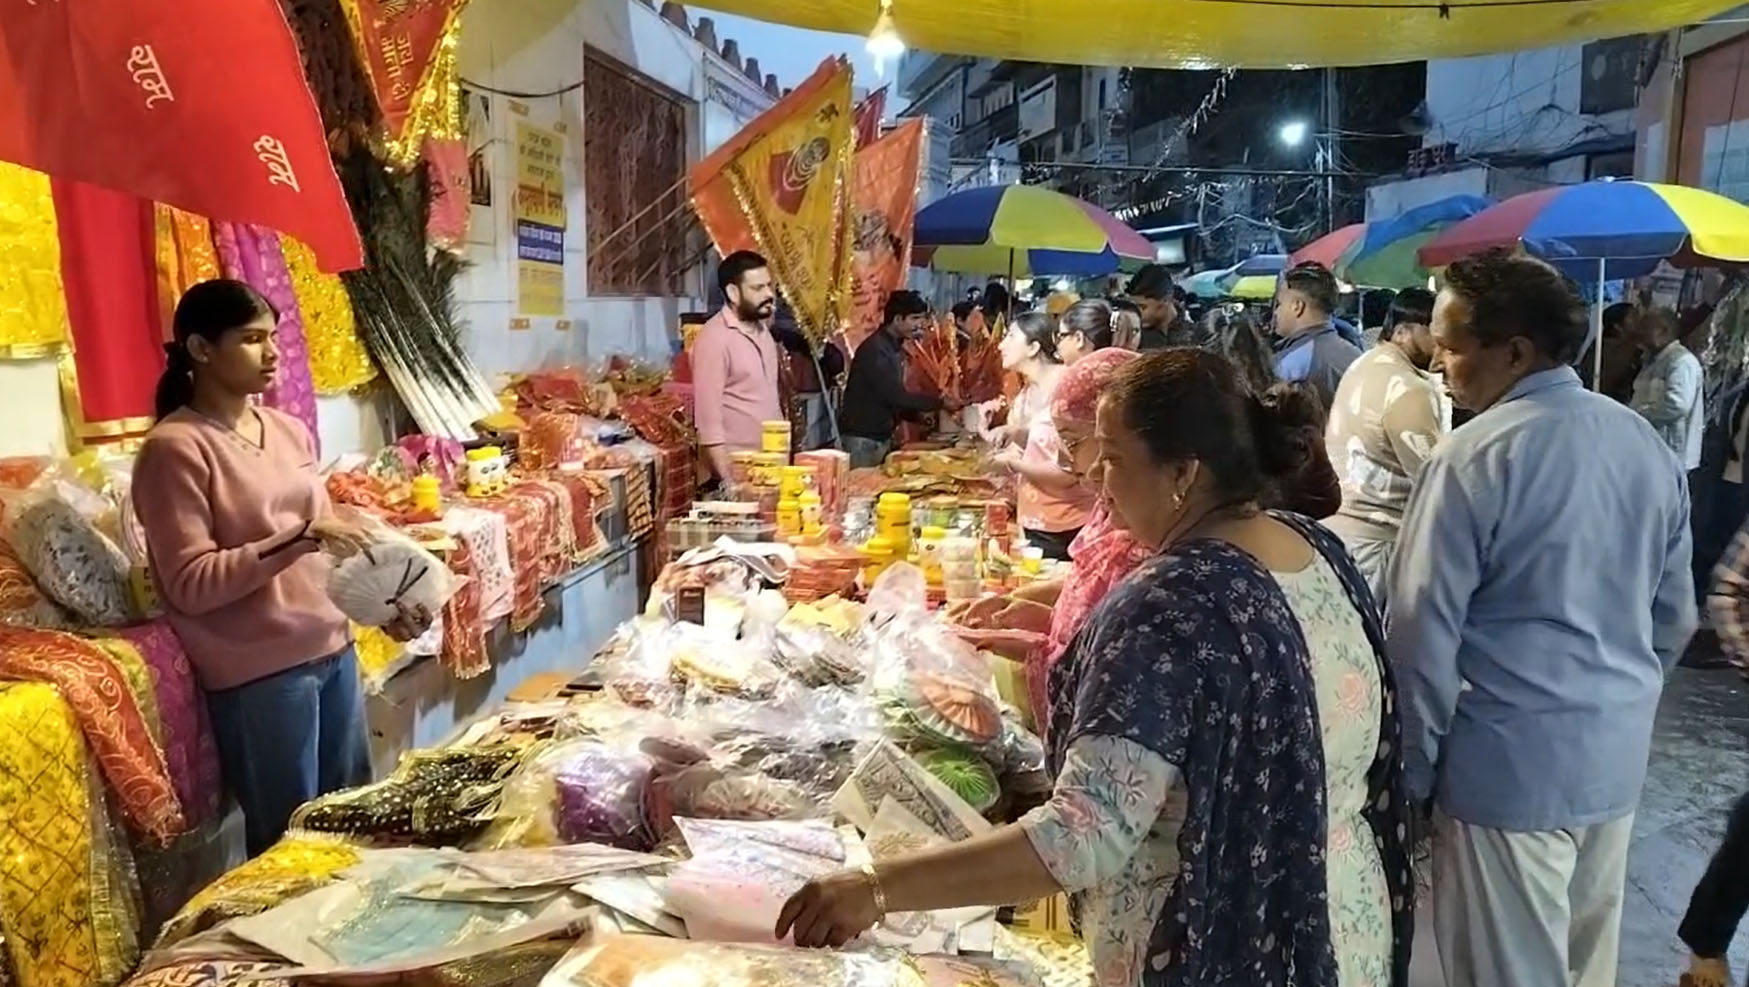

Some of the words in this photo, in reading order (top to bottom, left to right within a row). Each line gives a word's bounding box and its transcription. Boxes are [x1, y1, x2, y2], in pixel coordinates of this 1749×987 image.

[127, 44, 175, 109] राम
[381, 36, 402, 79] माता
[392, 80, 411, 101] दी
[253, 135, 301, 192] राम
